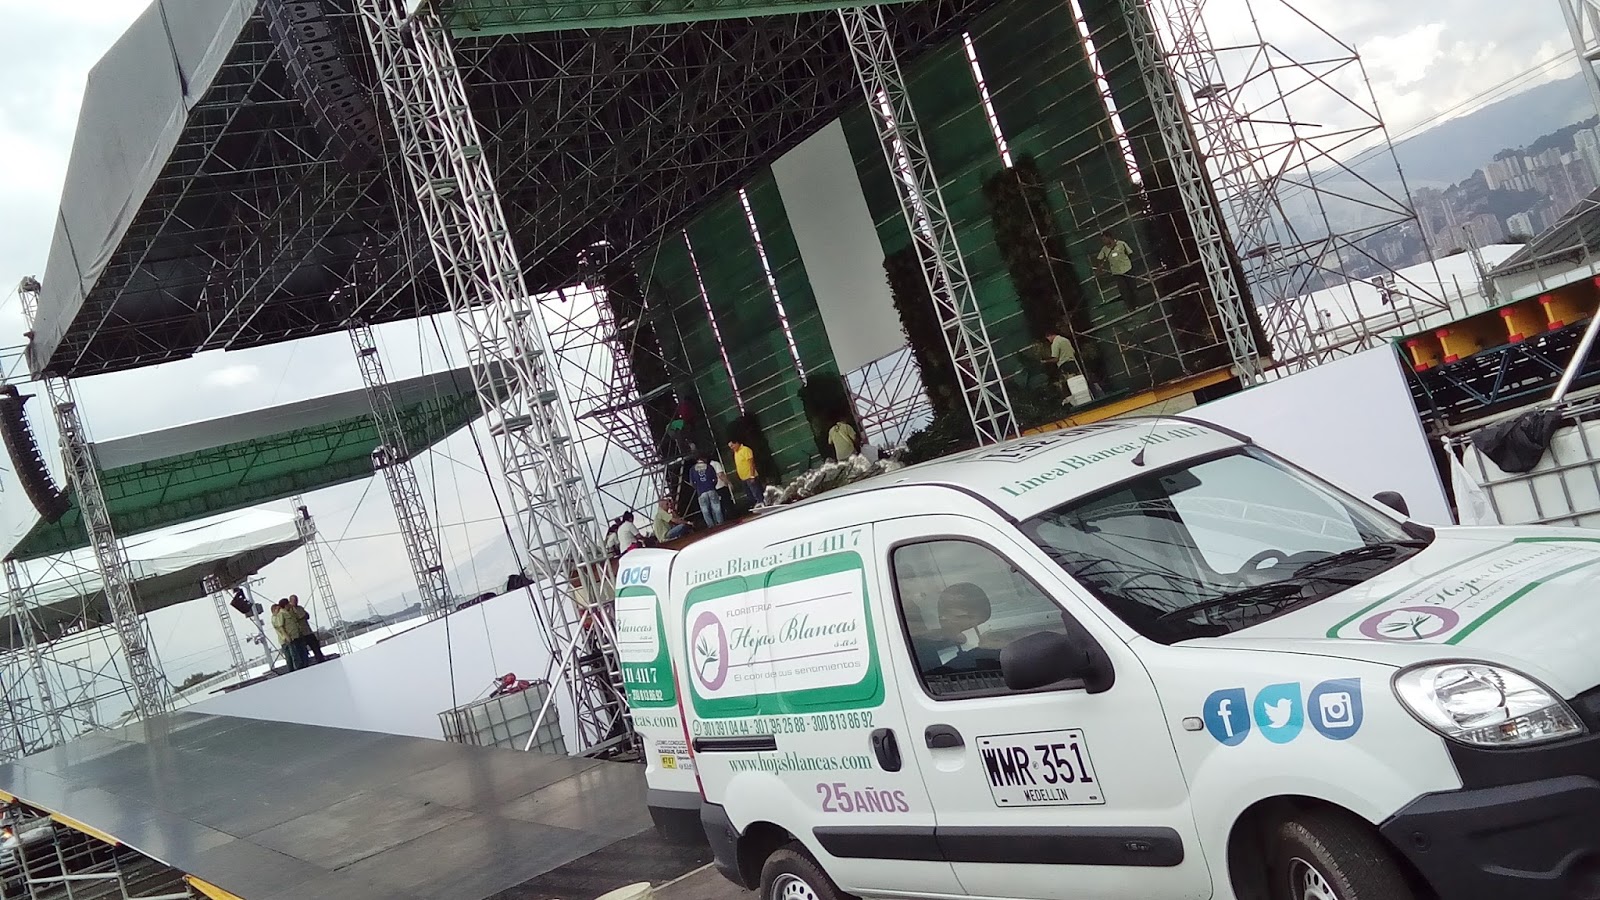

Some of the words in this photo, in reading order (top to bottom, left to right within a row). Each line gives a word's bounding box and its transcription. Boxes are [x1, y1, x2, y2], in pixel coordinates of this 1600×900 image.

[999, 465, 1068, 497] Linea
[685, 569, 723, 586] Linea
[726, 553, 783, 575] Blanca:
[787, 541, 812, 560] 411
[818, 534, 845, 553] 411
[850, 529, 862, 546] 7
[729, 624, 776, 668] Hojas
[779, 613, 858, 645] Blancas
[783, 717, 794, 733] 25
[794, 716, 806, 732] 88
[811, 714, 829, 732] 300
[847, 711, 861, 729] 86
[862, 711, 875, 728] 92
[729, 751, 873, 776] www.hojasblancas.com
[981, 747, 1037, 787] WMR
[1034, 742, 1093, 784] 351
[1023, 788, 1070, 802] MEDELLIN
